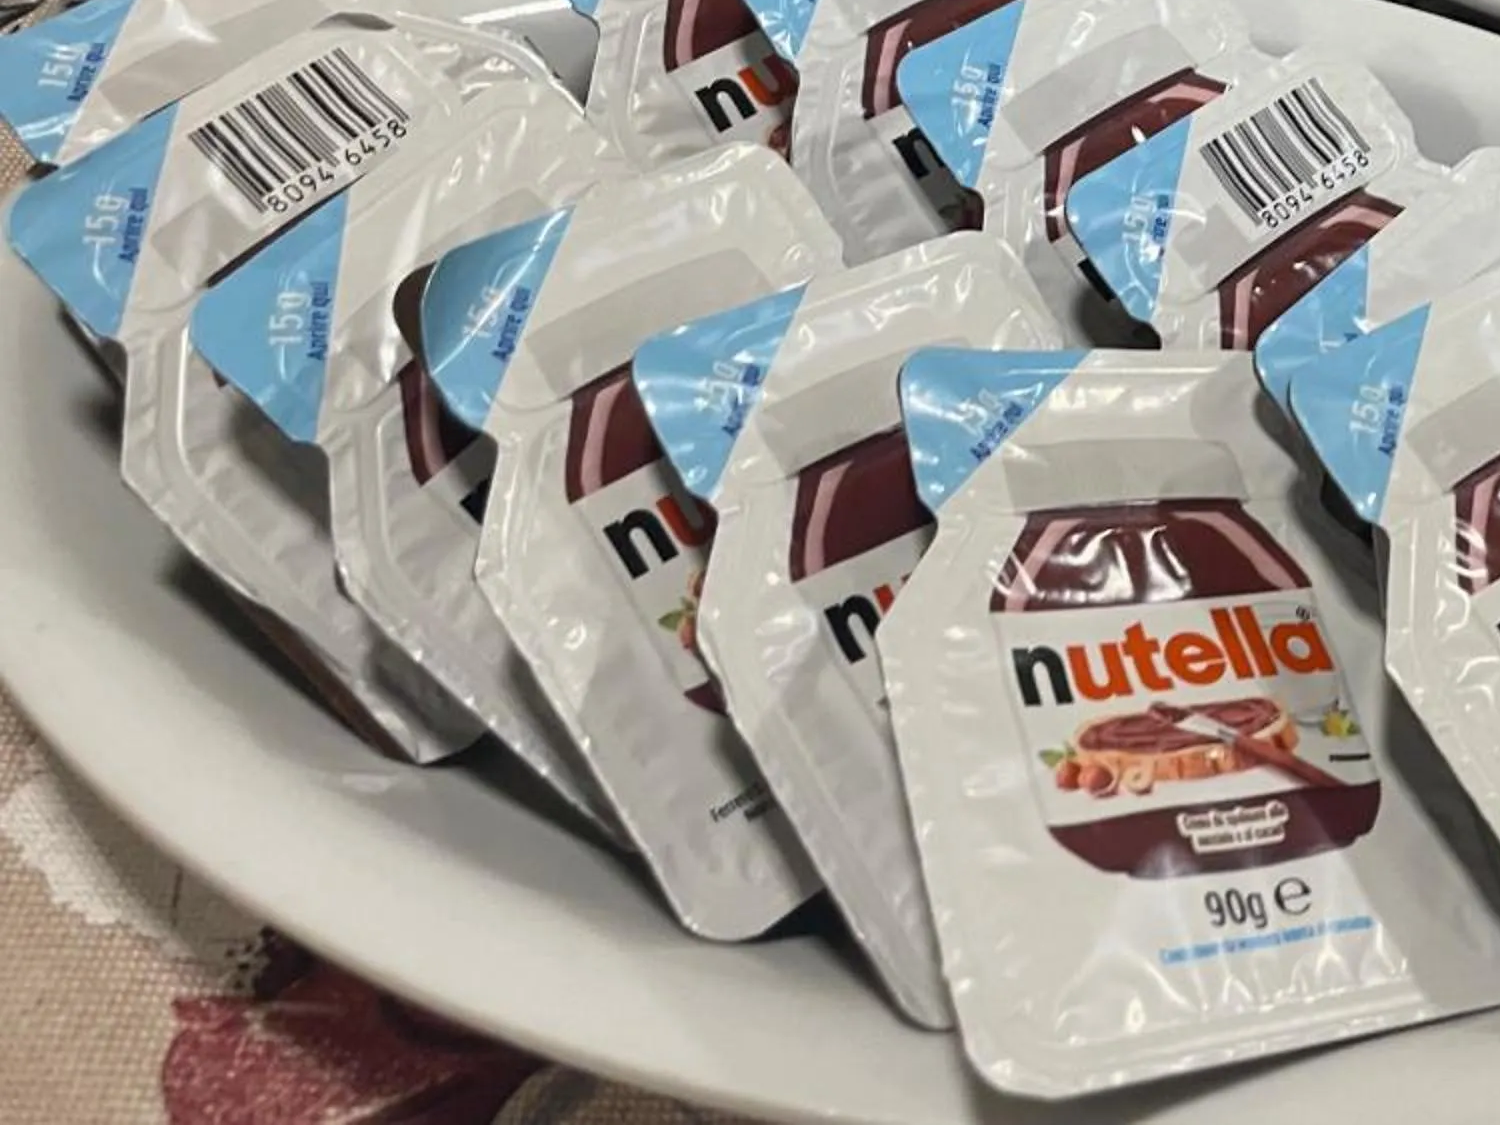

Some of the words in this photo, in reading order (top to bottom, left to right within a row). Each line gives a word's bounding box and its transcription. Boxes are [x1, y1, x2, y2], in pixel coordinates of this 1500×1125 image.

[265, 166, 336, 217] 8094
[345, 119, 409, 168] 6458
[1261, 191, 1316, 231] 8094
[1319, 149, 1373, 192] 6458
[268, 291, 312, 347] 15g
[305, 309, 330, 361] Aprire
[1012, 606, 1333, 706] nutella
[1203, 886, 1269, 930] 90g
